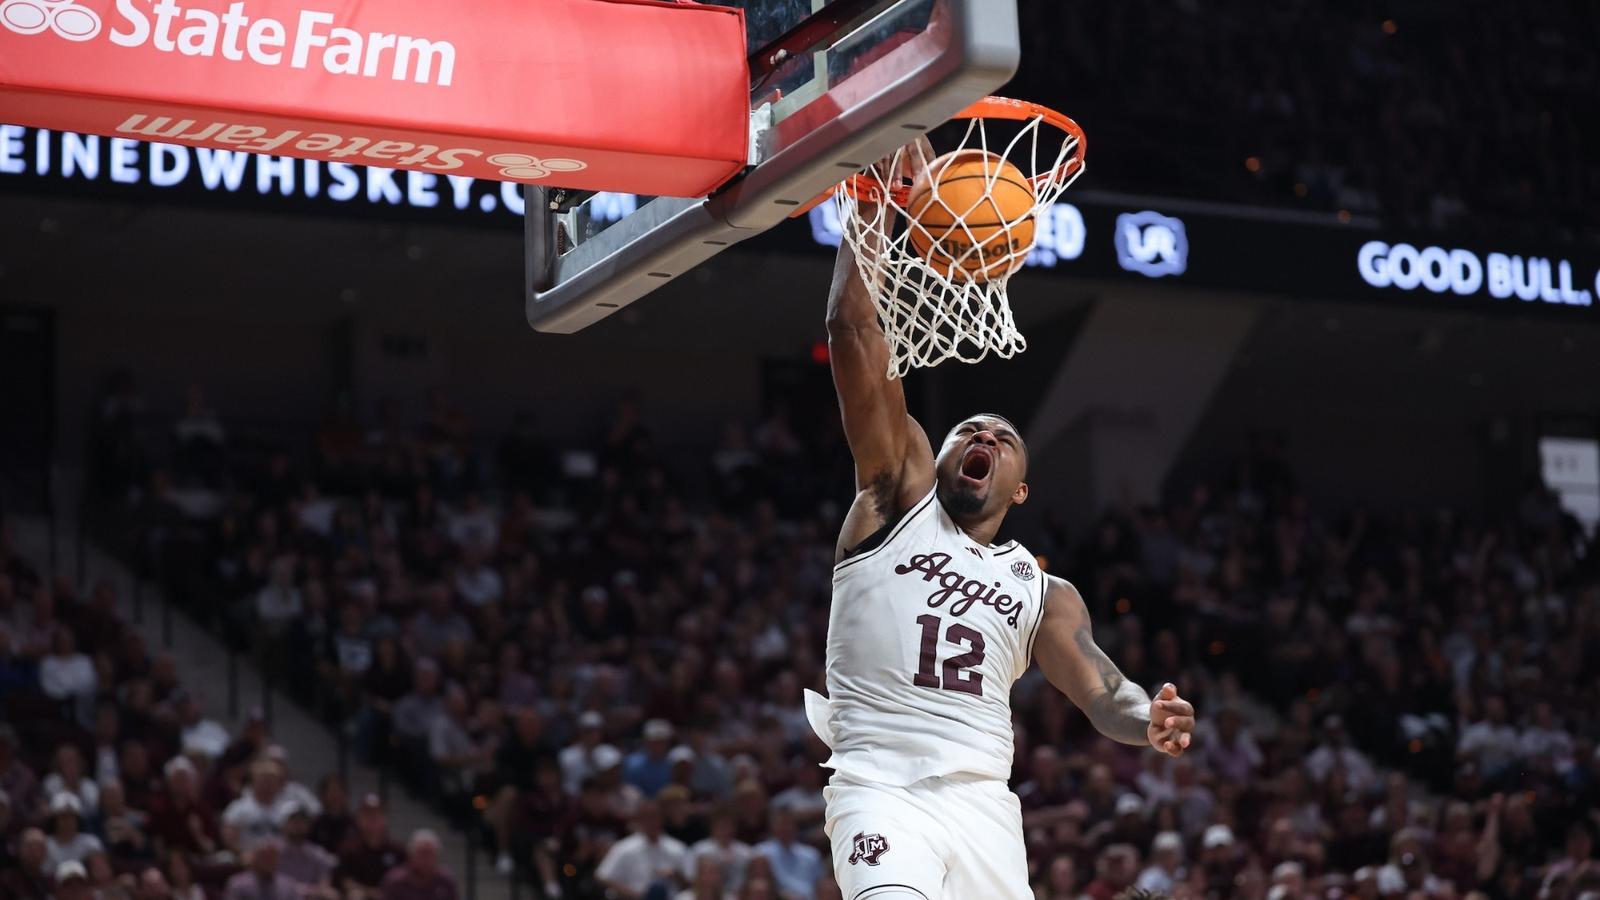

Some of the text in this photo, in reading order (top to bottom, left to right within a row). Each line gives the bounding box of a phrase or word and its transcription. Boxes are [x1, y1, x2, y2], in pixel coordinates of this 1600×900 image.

[109, 0, 456, 87] State Farm
[115, 113, 484, 170] State Farm
[1358, 240, 1483, 295] GOOD
[1487, 252, 1592, 306] BULL.
[895, 552, 1023, 629] Aggies
[1014, 561, 1032, 577] SEC
[913, 613, 986, 696] 12
